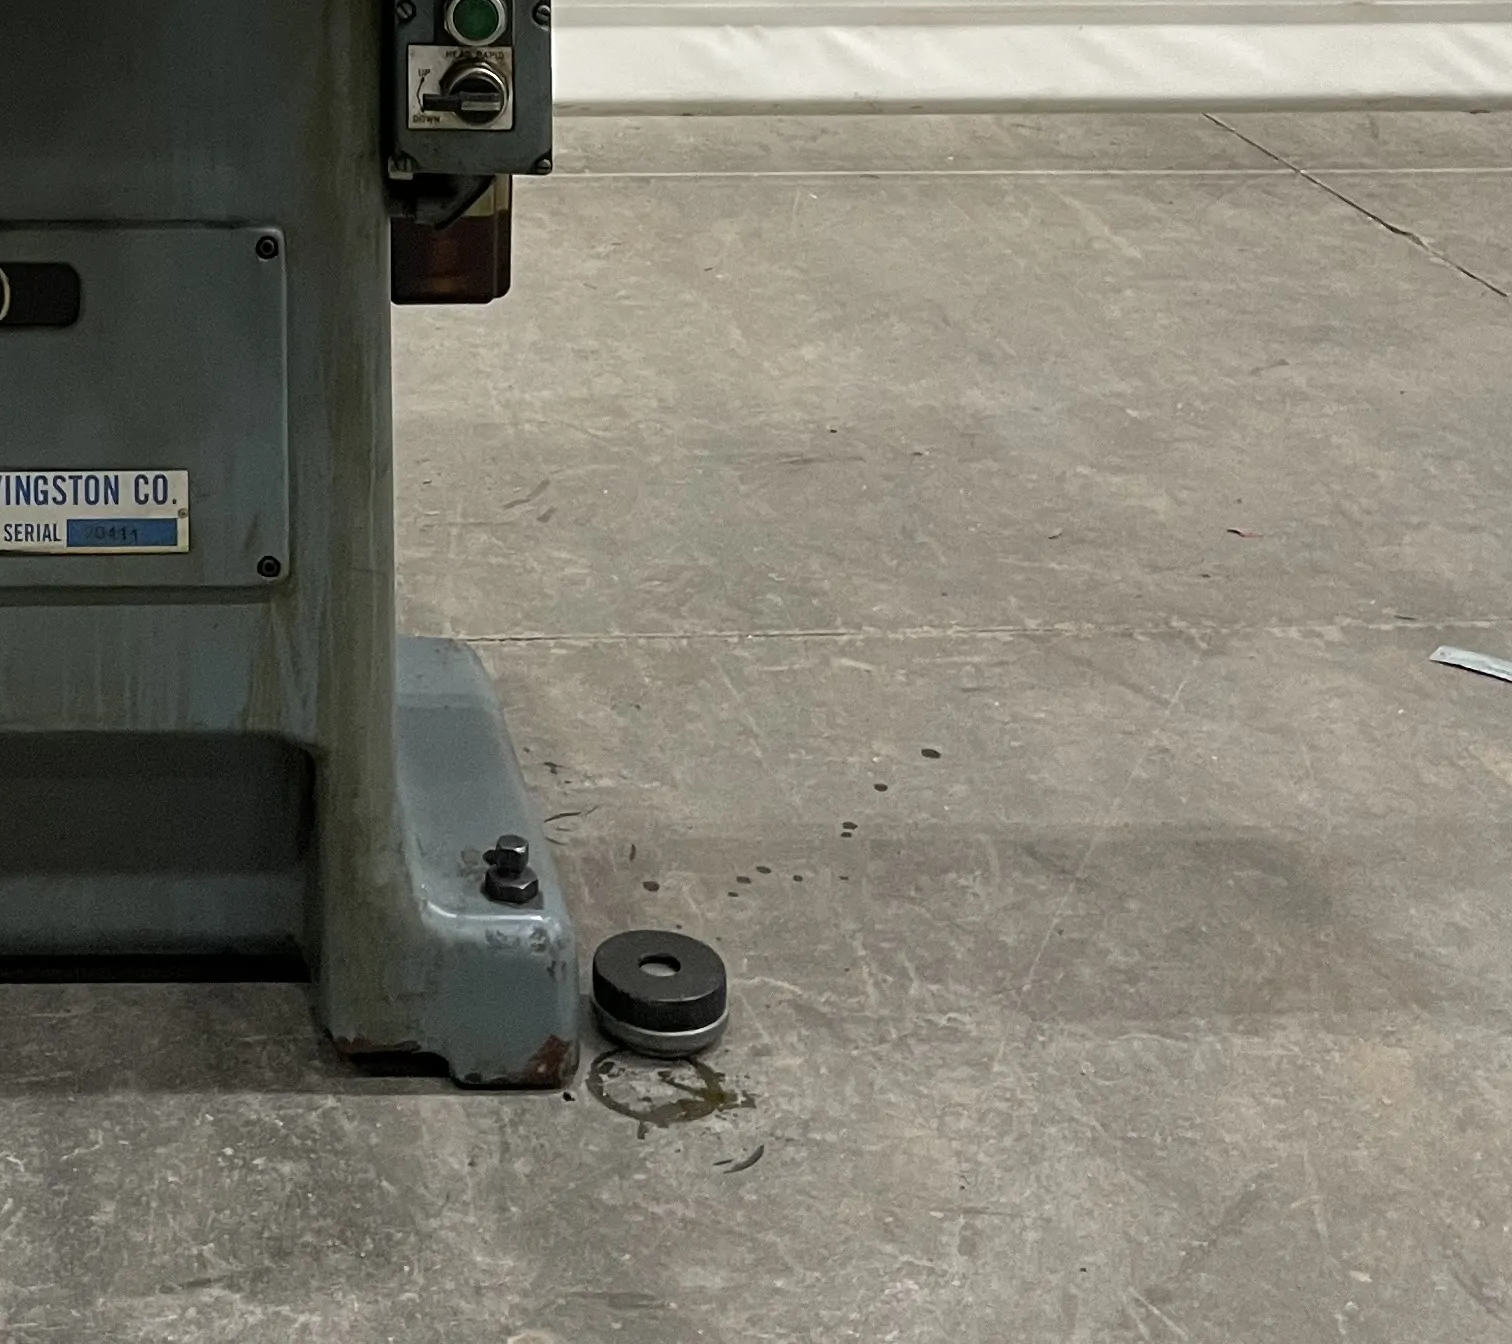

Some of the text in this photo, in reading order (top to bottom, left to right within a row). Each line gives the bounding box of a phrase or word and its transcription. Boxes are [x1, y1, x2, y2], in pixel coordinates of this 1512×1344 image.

[445, 50, 505, 61] HEAD RAPID
[417, 68, 431, 77] UP
[412, 114, 441, 124] DOWN
[133, 473, 178, 506] CO.
[3, 523, 62, 543] SERIAL
